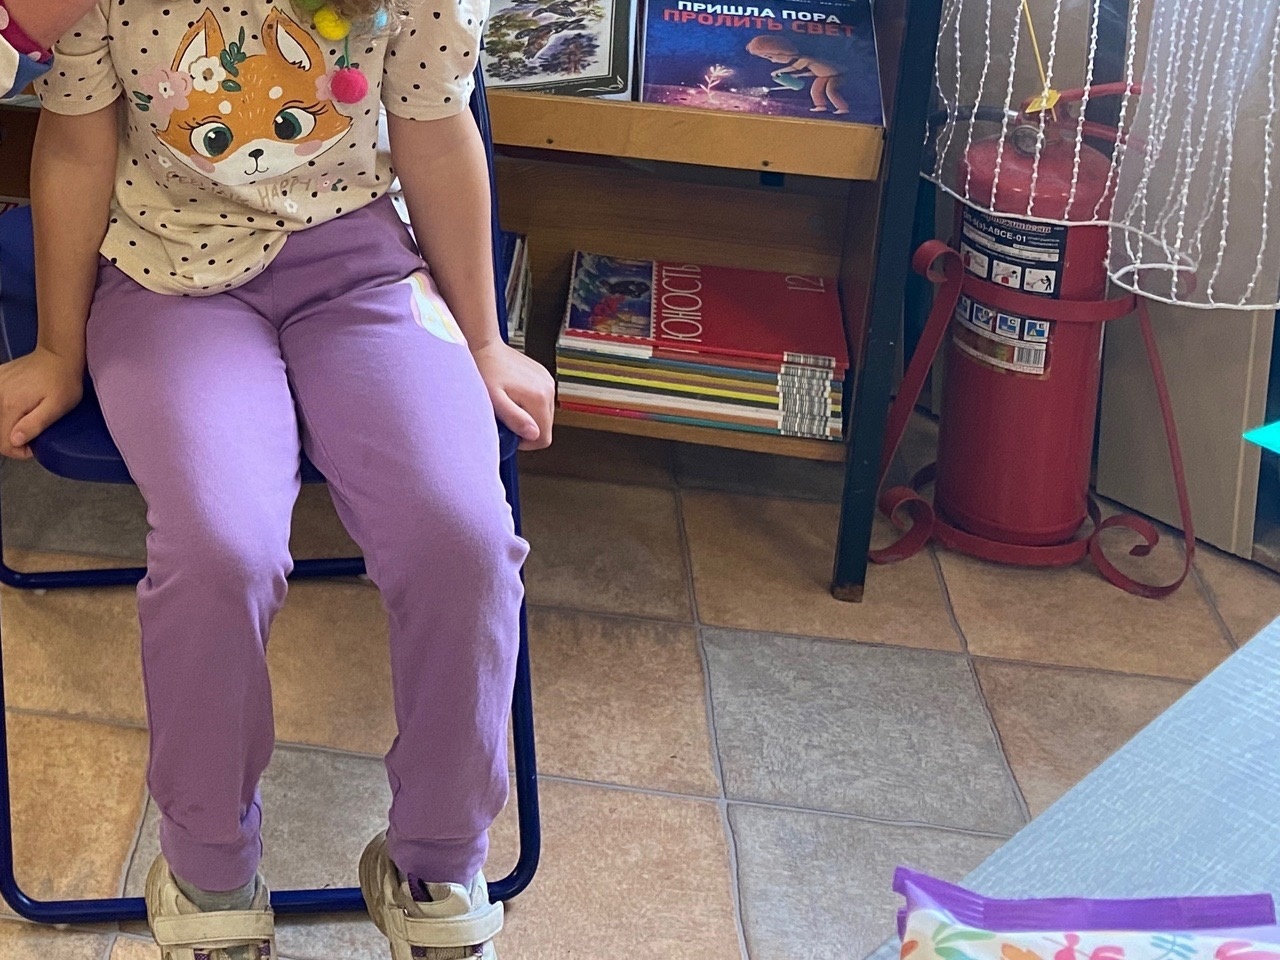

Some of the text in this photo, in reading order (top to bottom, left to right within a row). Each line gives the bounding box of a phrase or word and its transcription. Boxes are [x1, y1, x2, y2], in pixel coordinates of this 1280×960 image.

[663, 9, 855, 38] ПРОЛИТЬ СВЕТ
[678, 0, 841, 24] ПРИШЛА ПОРА
[785, 275, 825, 293] 12
[661, 264, 702, 342] ЮНОСТЬ
